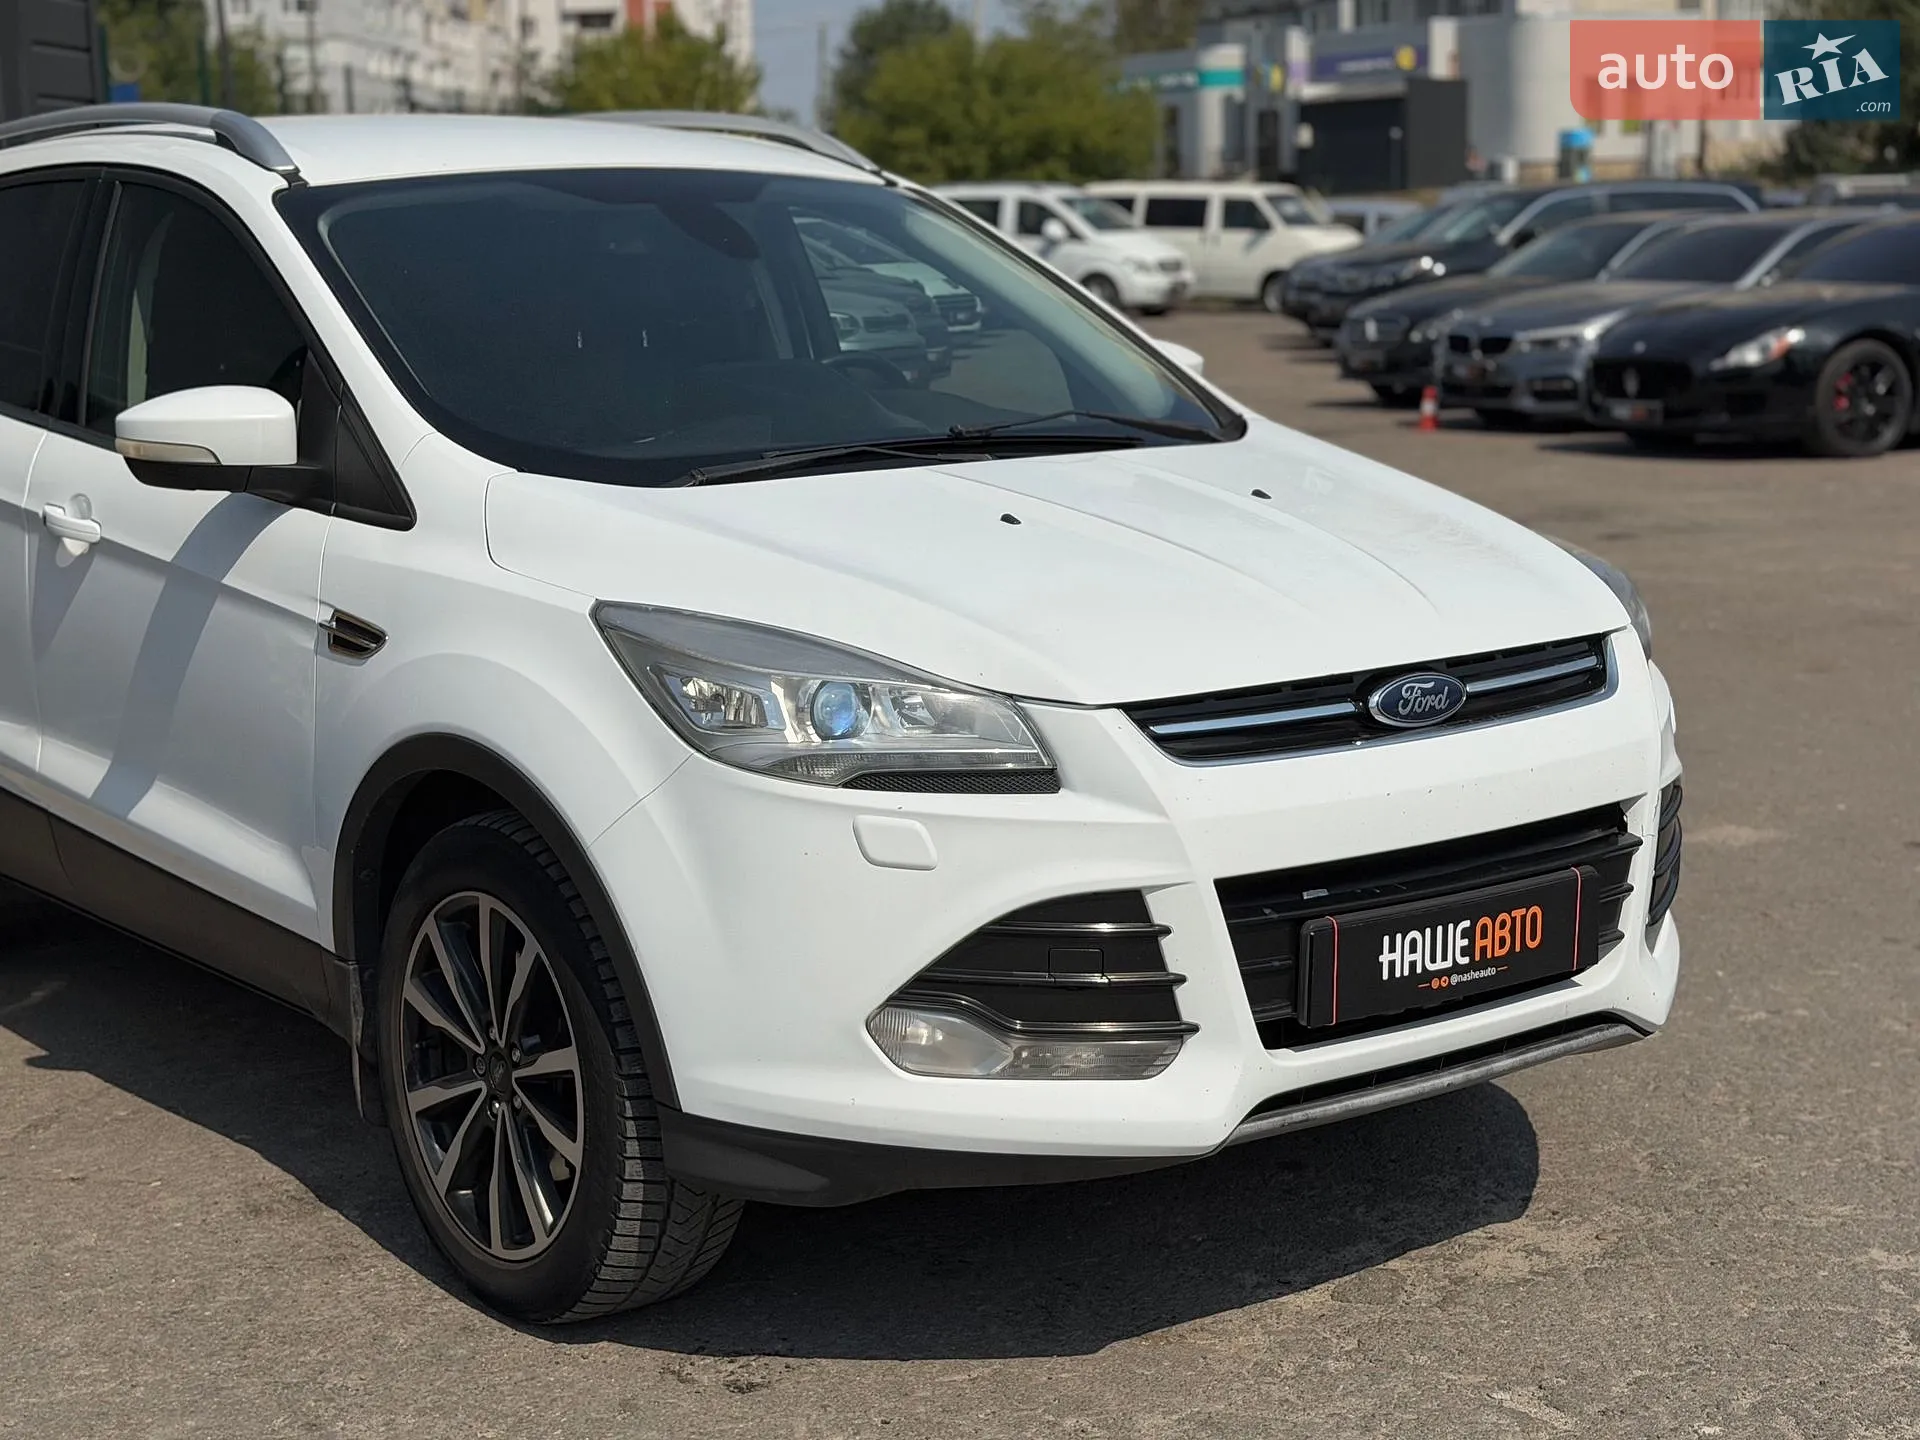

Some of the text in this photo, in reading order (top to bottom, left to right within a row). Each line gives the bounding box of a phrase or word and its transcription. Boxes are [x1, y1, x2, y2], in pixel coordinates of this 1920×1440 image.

[1398, 681, 1450, 716] Ford
[1379, 905, 1542, 981] НАШЕ АВТО
[1450, 966, 1497, 986] @nasheauto
